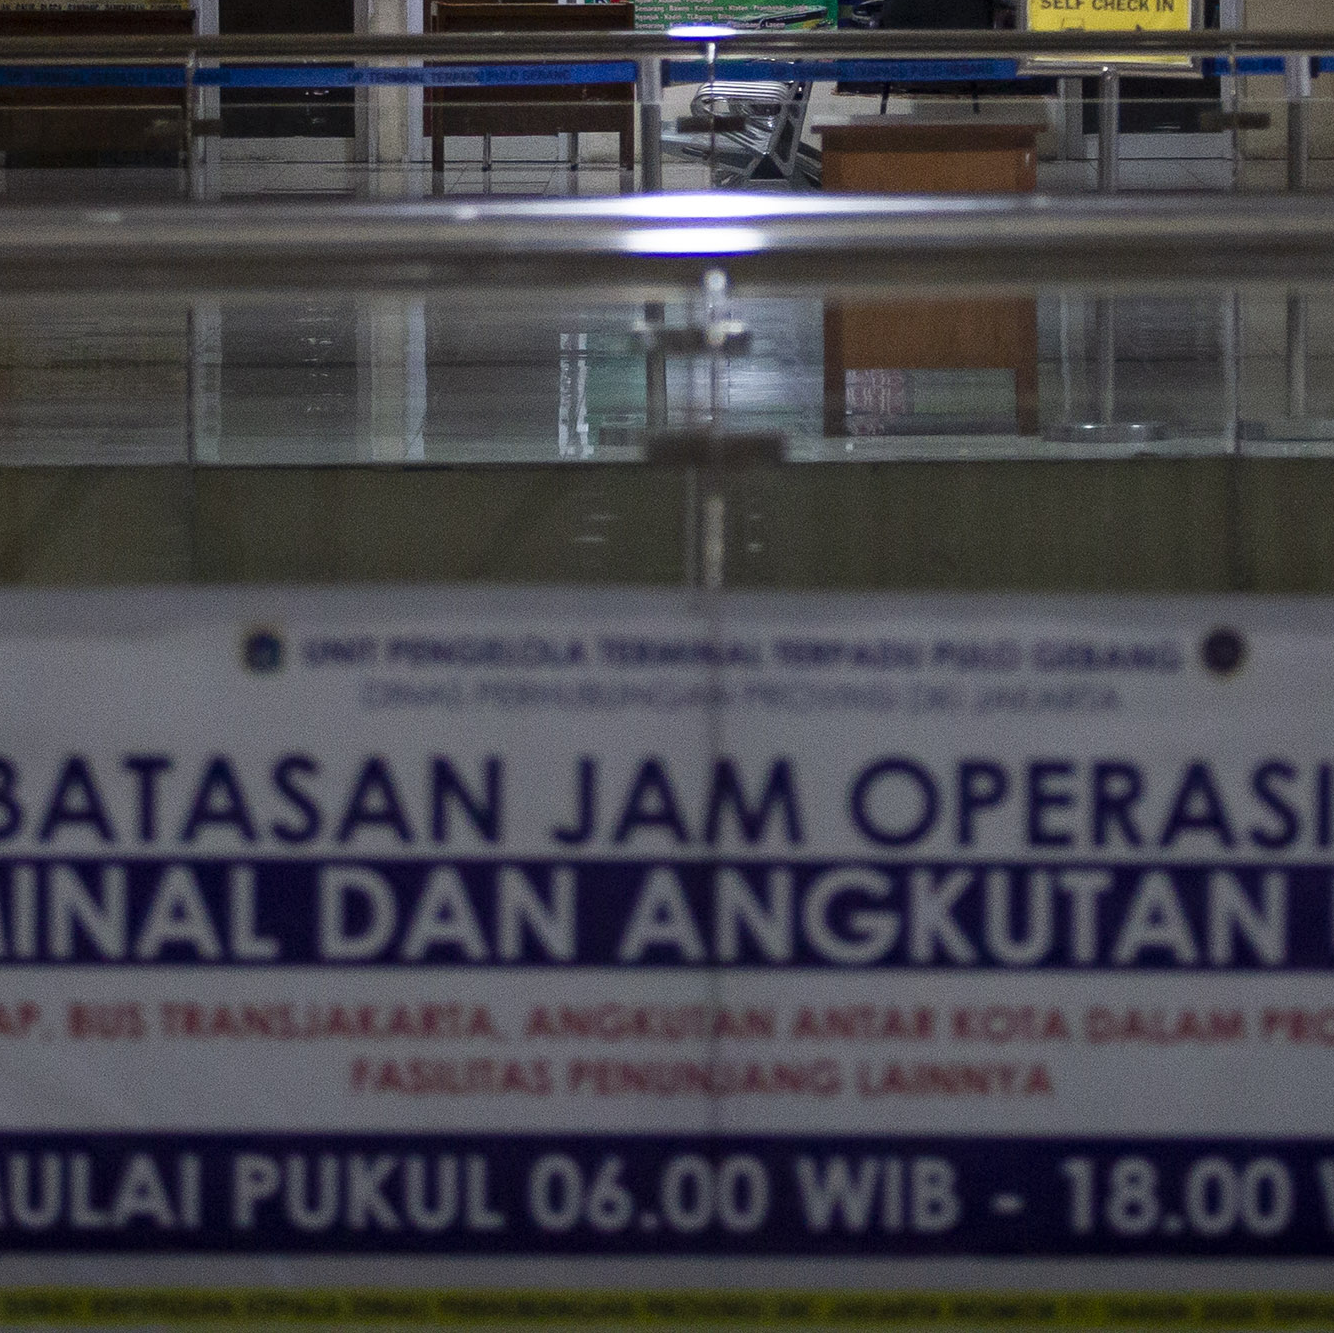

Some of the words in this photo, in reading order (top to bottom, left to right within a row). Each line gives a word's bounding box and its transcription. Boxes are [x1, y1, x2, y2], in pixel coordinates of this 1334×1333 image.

[552, 752, 804, 850] JAM
[320, 869, 571, 958] DAN
[622, 869, 1285, 962] ANGKUTAN
[67, 1000, 148, 1043] BUS
[158, 1001, 512, 1046] TRANSJAKARTA,
[522, 1004, 777, 1045] ANGKUTAN
[790, 1005, 936, 1046] ANTAR
[953, 1006, 1068, 1047] KOTA
[1083, 1007, 1245, 1049] DALAM
[349, 1055, 555, 1097] FASILITAS
[567, 1056, 843, 1101] PENUNJANG
[856, 1058, 1053, 1102] LAINNYA
[234, 1154, 505, 1232] PUKUL
[528, 1155, 770, 1233] 06.00
[797, 1157, 962, 1234] WIB
[1061, 1157, 1294, 1236] 18.00
